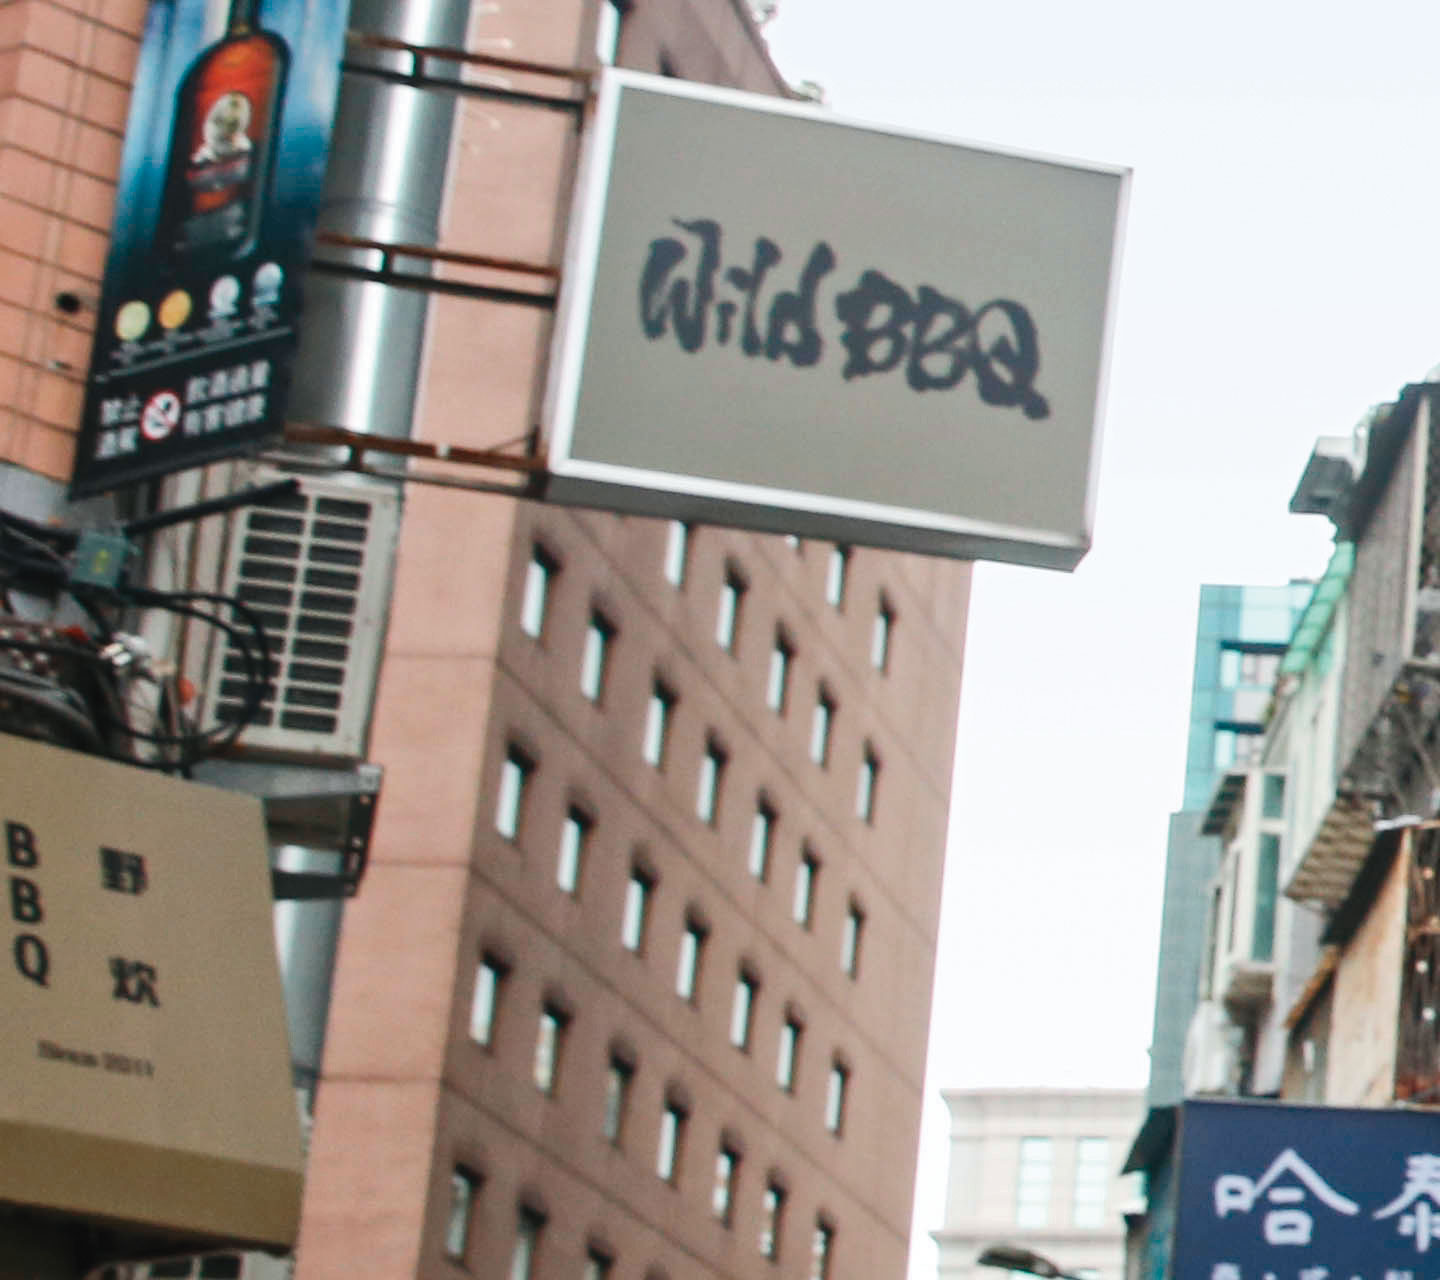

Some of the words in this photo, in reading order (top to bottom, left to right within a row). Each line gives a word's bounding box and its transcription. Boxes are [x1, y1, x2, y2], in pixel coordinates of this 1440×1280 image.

[638, 216, 836, 368] Wild
[836, 269, 1051, 421] BBQ
[4, 819, 51, 989] BBQ
